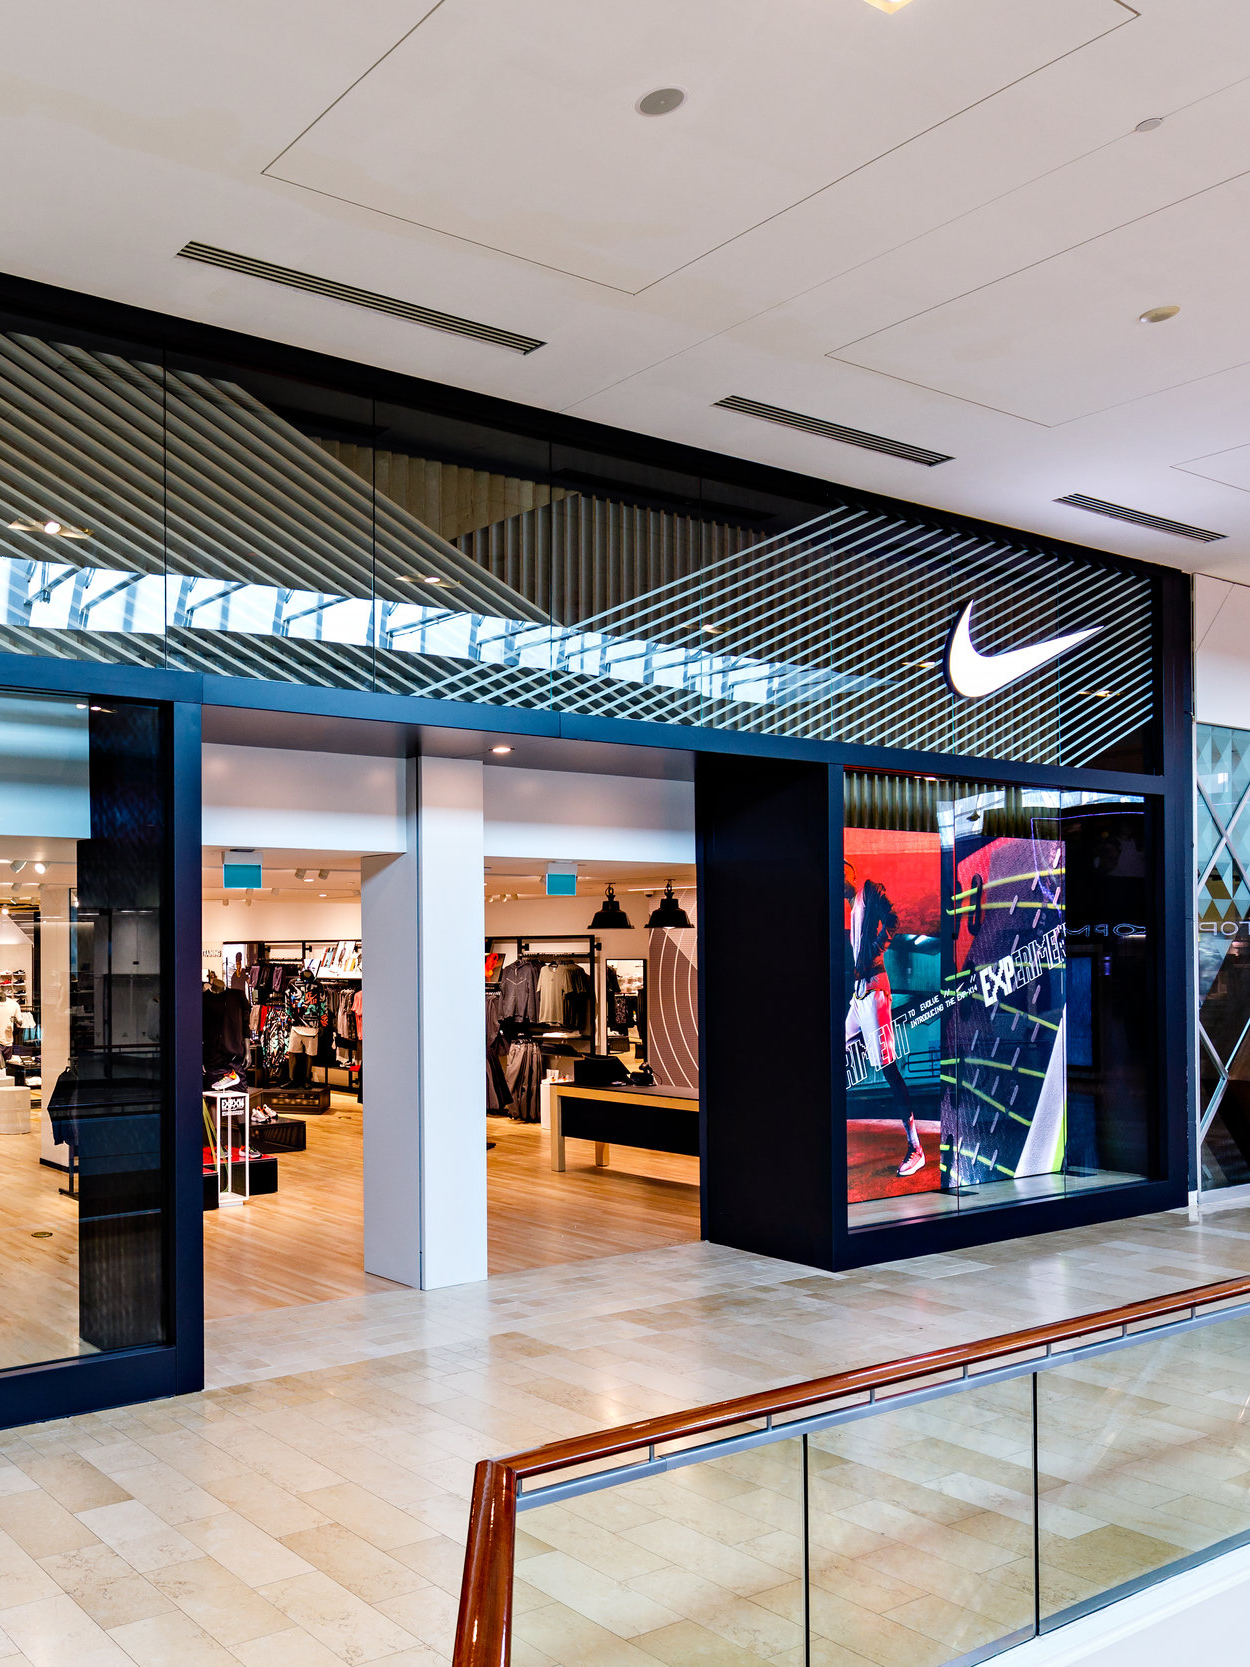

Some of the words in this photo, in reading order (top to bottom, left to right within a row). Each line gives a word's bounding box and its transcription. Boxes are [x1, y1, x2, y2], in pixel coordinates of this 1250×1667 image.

[910, 1003, 944, 1029] INTRODUCING
[945, 997, 957, 1008] THE
[919, 994, 940, 1012] EVOLVE
